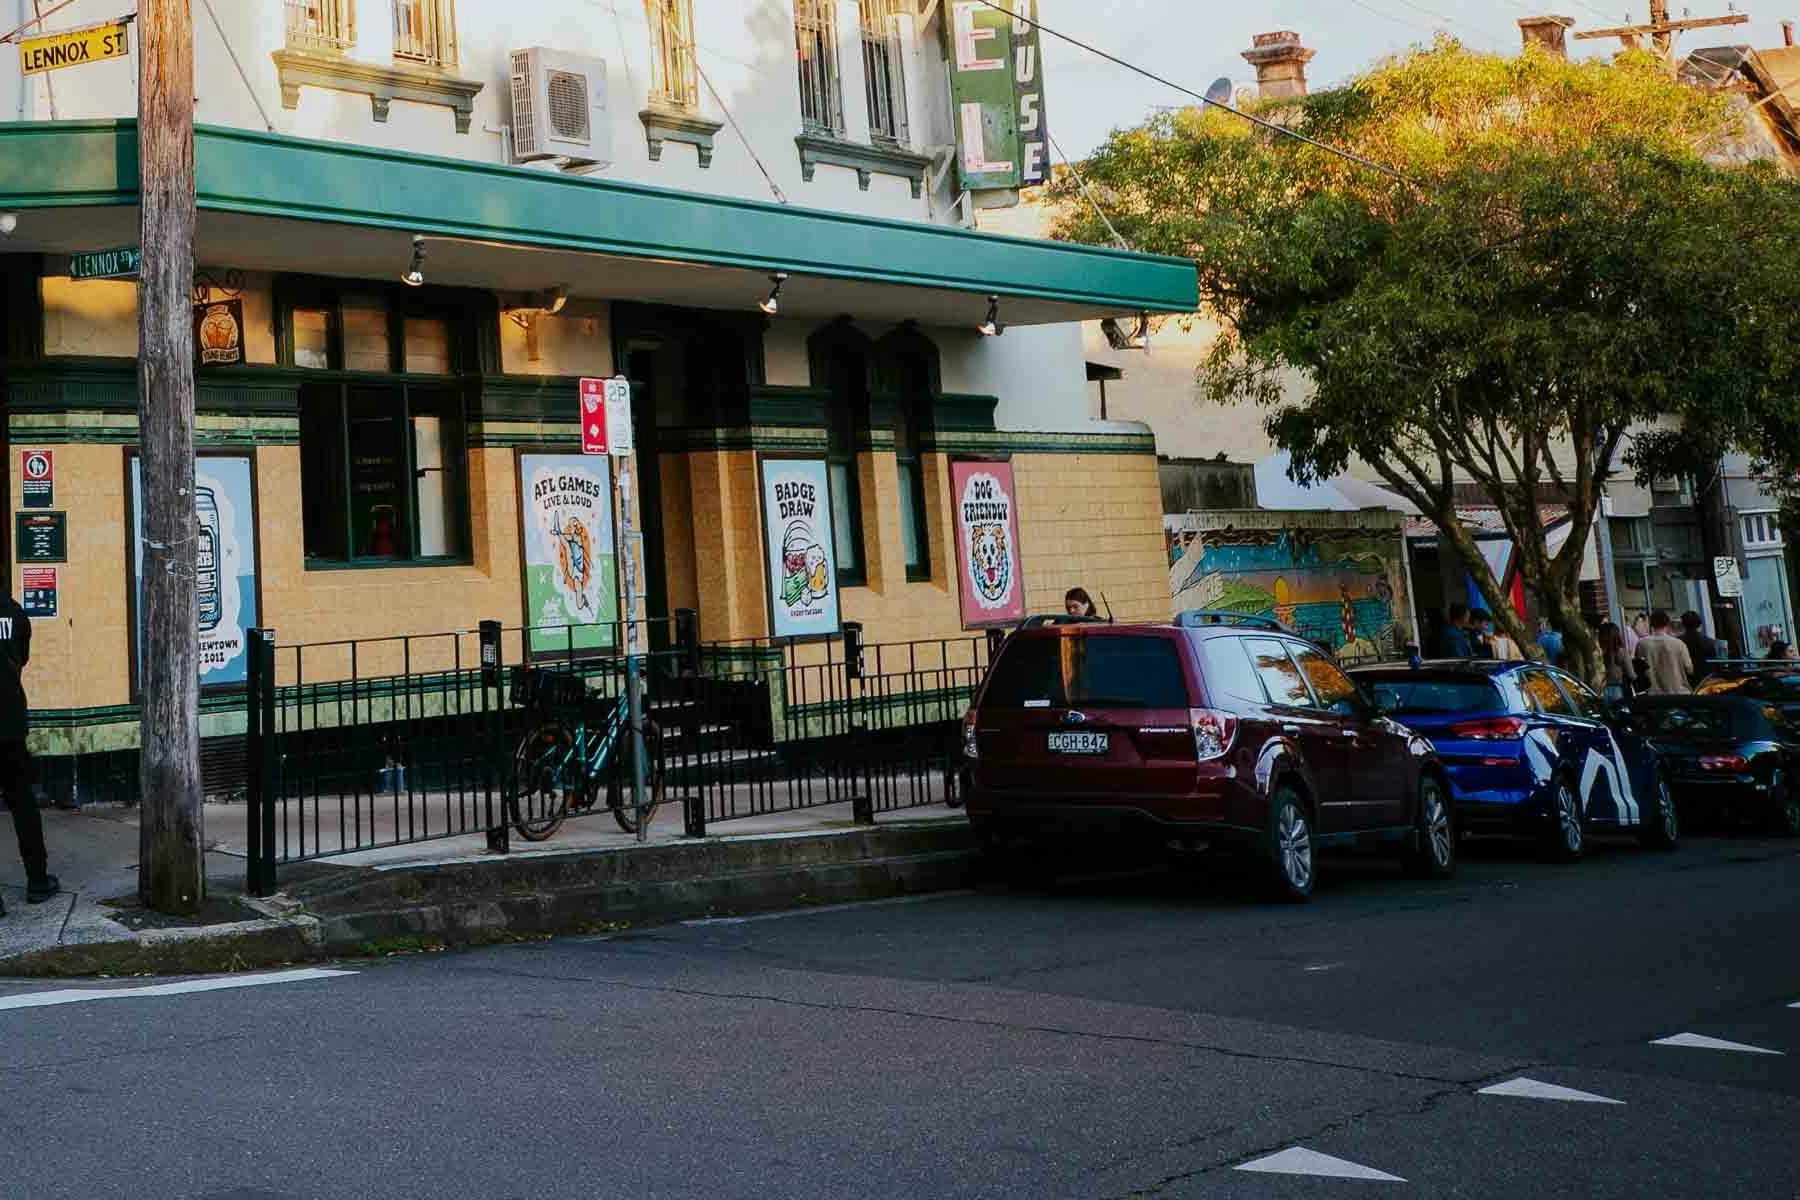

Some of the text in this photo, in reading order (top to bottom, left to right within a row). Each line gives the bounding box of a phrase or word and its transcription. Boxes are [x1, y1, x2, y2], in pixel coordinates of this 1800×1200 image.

[24, 39, 90, 71] LENNOX
[103, 32, 124, 56] ST
[79, 252, 119, 277] LENNOX
[535, 476, 600, 501] AFL GAMES
[775, 481, 816, 502] BADGE
[974, 480, 993, 500] DOG
[543, 495, 561, 510] LIVE
[571, 494, 592, 509] LOUD
[779, 500, 814, 519] DRAW
[963, 502, 1008, 522] FRIENDLY
